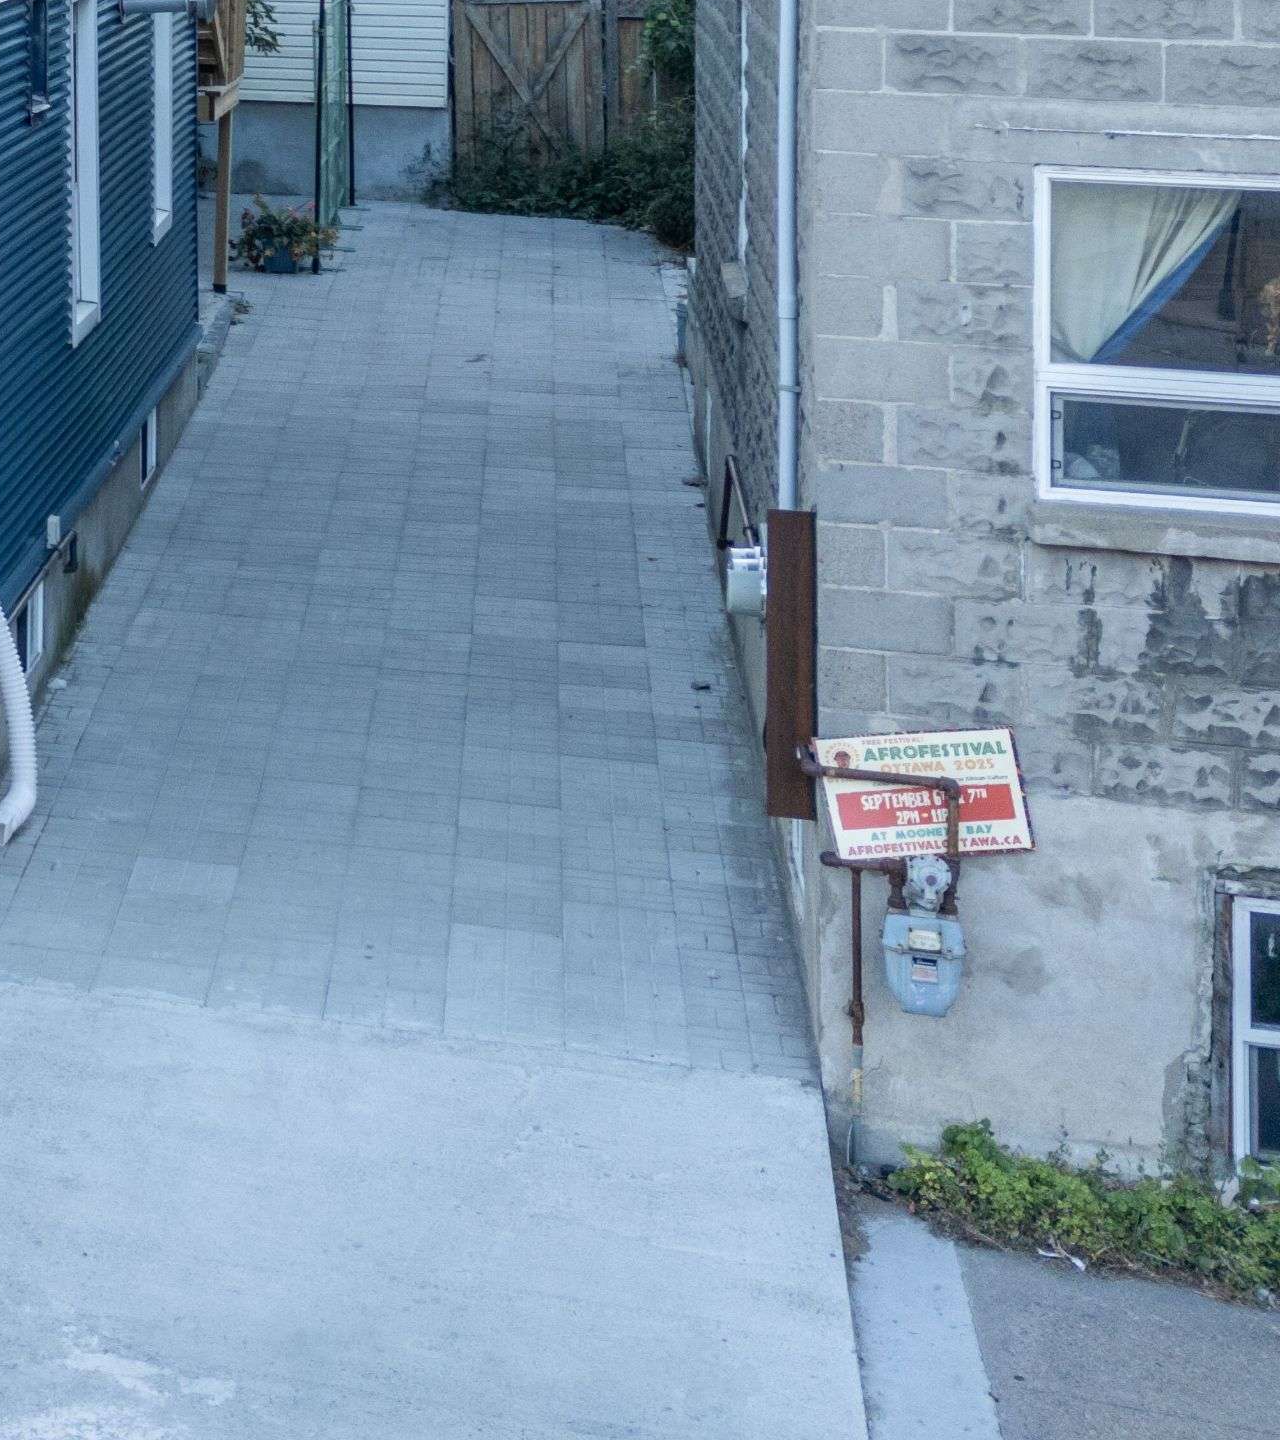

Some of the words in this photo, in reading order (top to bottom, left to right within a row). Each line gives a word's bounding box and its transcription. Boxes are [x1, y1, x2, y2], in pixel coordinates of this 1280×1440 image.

[863, 741, 1007, 762] AFROFESTIVAL
[954, 758, 995, 771] 2025
[860, 790, 931, 811] SEPTEMBER
[932, 790, 945, 807] 6T
[967, 788, 988, 805] 7TH
[895, 810, 920, 825] 2PM
[931, 809, 948, 824] 11P
[870, 830, 888, 843] AT
[966, 823, 993, 836] BAY
[848, 835, 1023, 857] AFROFESTIVALOTAWA.CA
